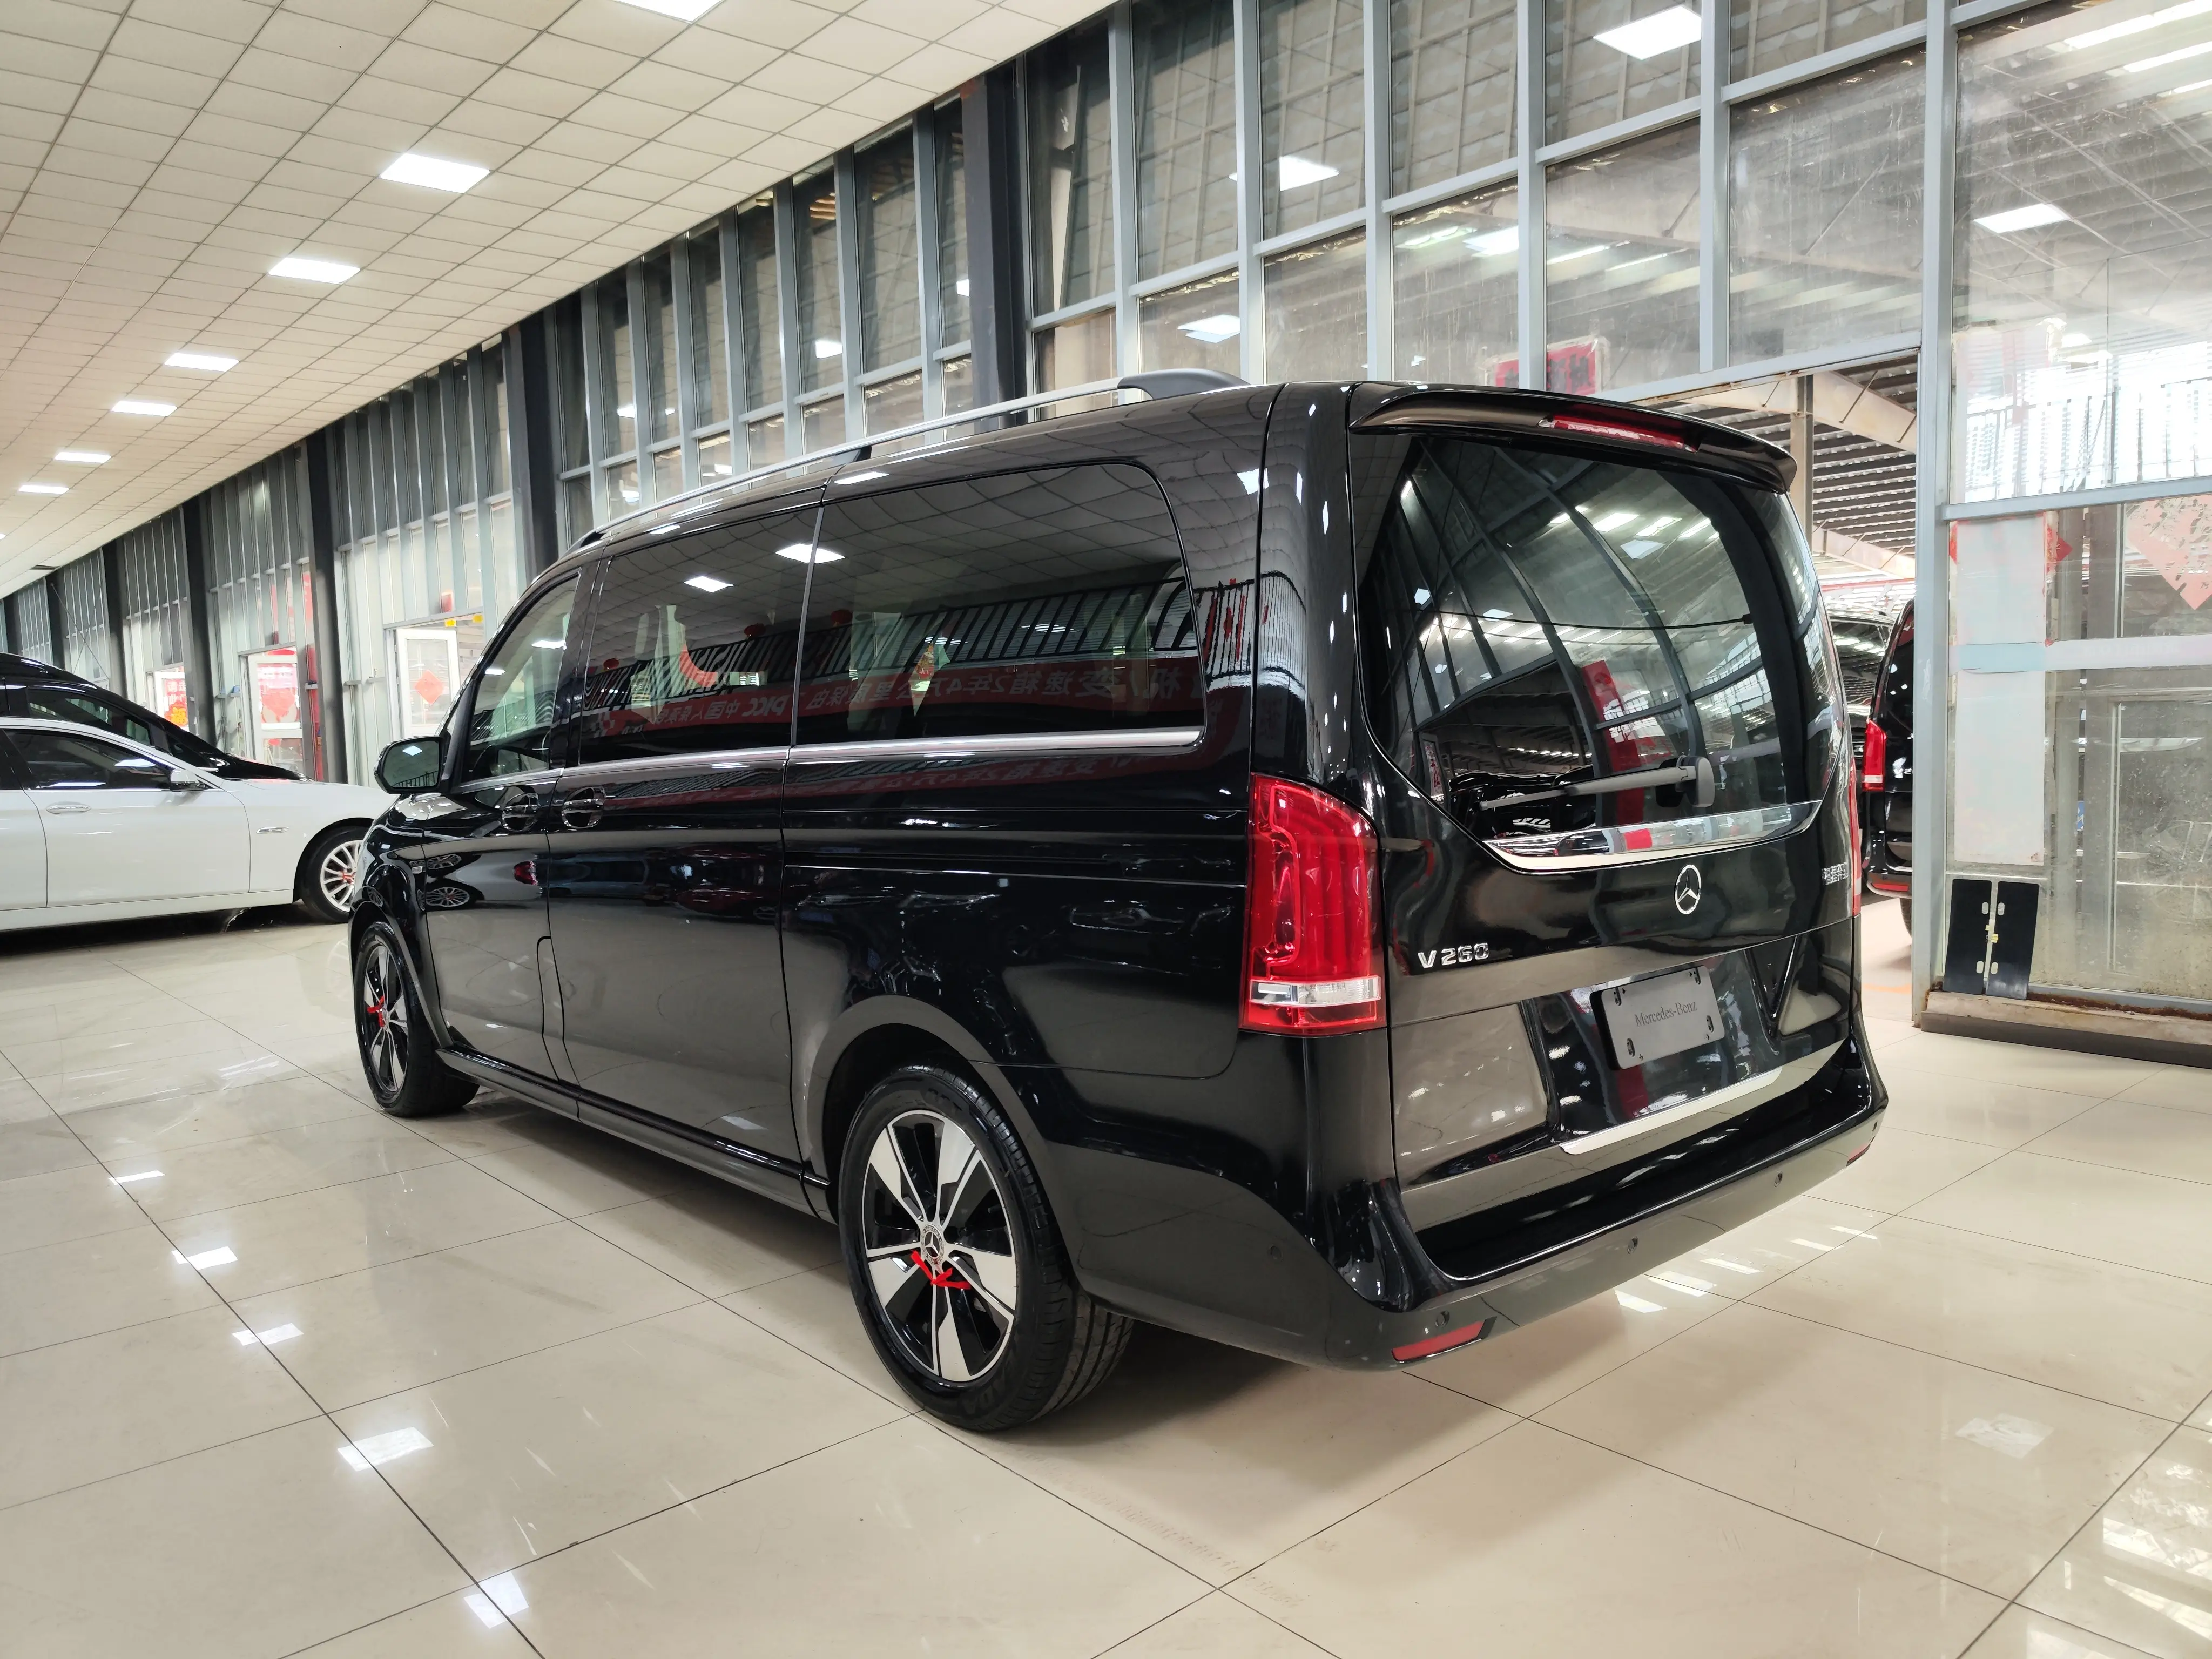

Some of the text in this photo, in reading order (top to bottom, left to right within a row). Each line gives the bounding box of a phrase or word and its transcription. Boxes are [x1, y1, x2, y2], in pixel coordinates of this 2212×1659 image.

[1417, 942, 1489, 969] V 260
[1634, 1001, 1698, 1027] Mercedes-Benz
